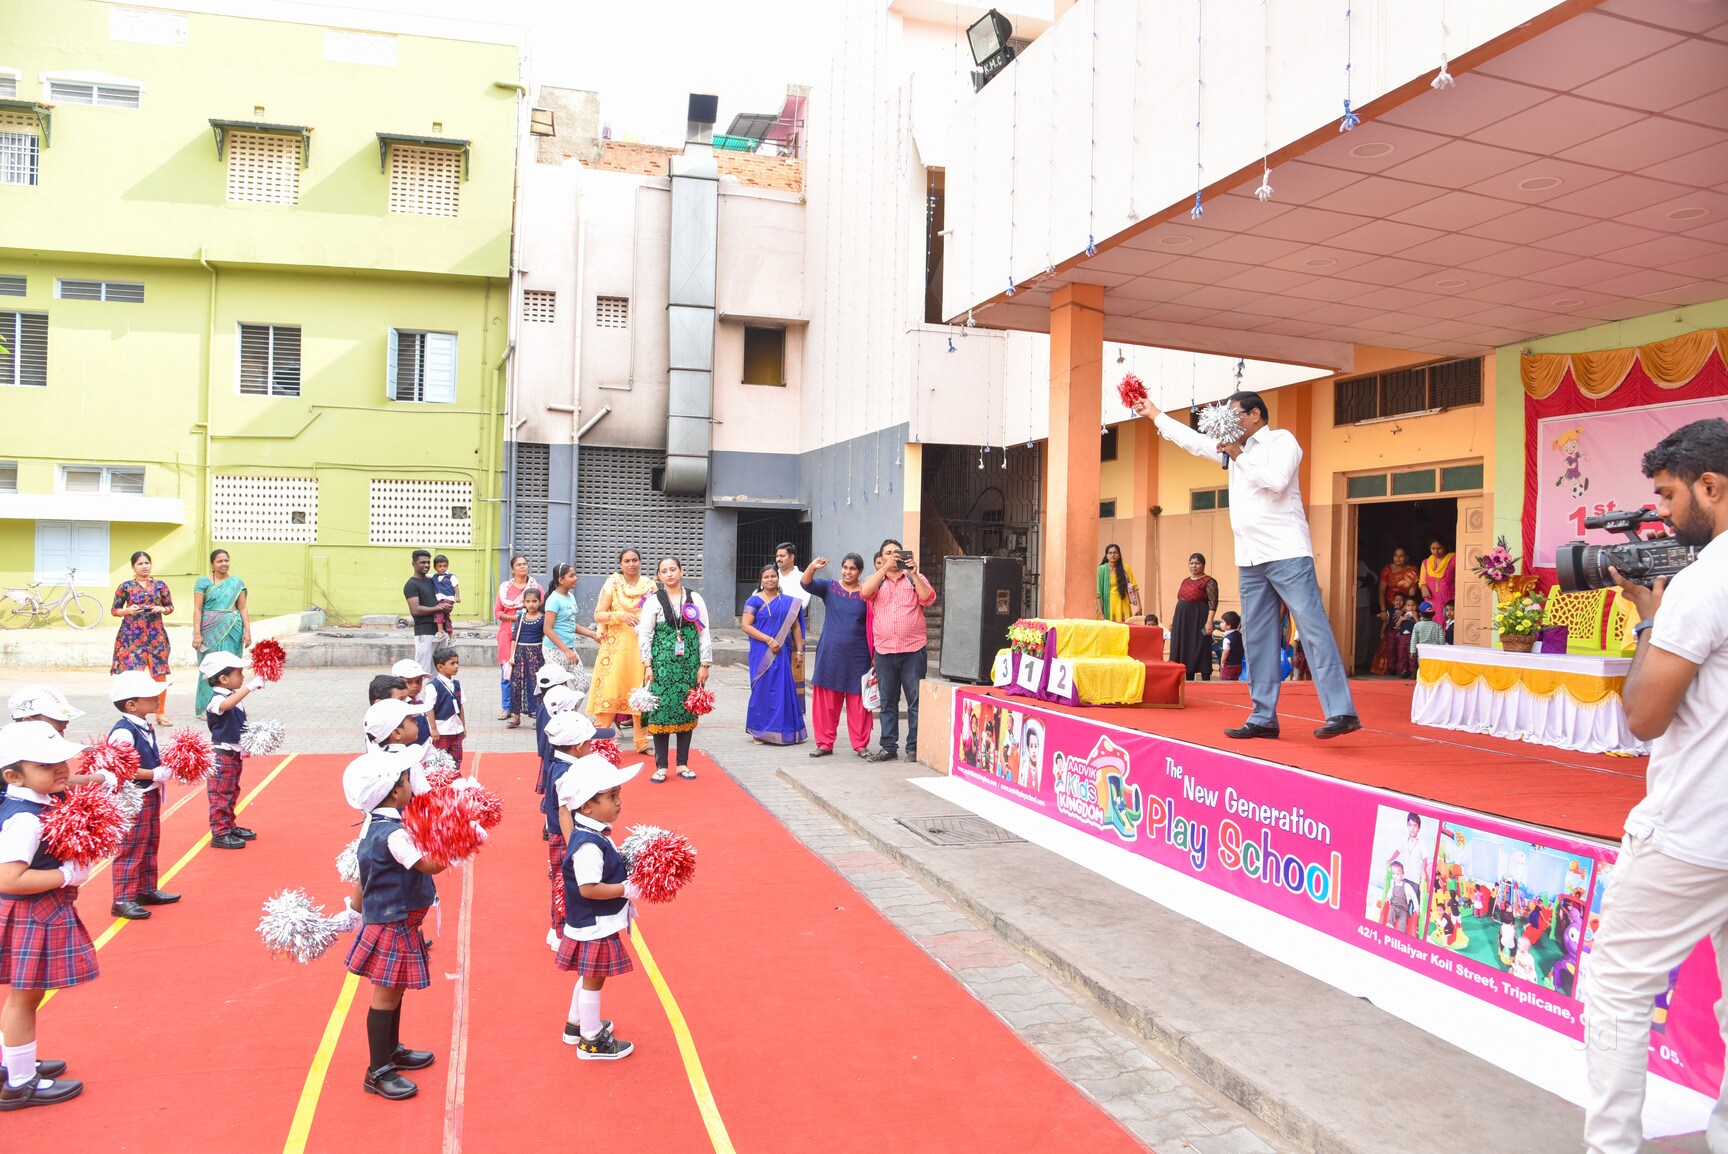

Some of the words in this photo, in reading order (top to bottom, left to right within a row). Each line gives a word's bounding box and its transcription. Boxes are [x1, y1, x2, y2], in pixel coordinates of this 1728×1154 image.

[1002, 658, 1009, 678] 3
[1024, 660, 1035, 682] 1
[1057, 664, 1066, 690] 2
[1068, 759, 1097, 780] AADVIK
[1067, 772, 1096, 802] Kids
[1165, 756, 1183, 780] The
[1183, 775, 1219, 808] New
[1225, 786, 1331, 845] Generation
[1059, 792, 1104, 826] KINGDOM
[1148, 795, 1207, 870] Play
[1219, 820, 1341, 909] School
[1357, 925, 1382, 945] 42/1,
[1384, 937, 1428, 963] Pillaiyar
[1430, 954, 1453, 975] Koil
[1455, 963, 1499, 992] Street,
[1502, 981, 1576, 1024] Triplicane,
[1660, 1045, 1684, 1067] 05.
